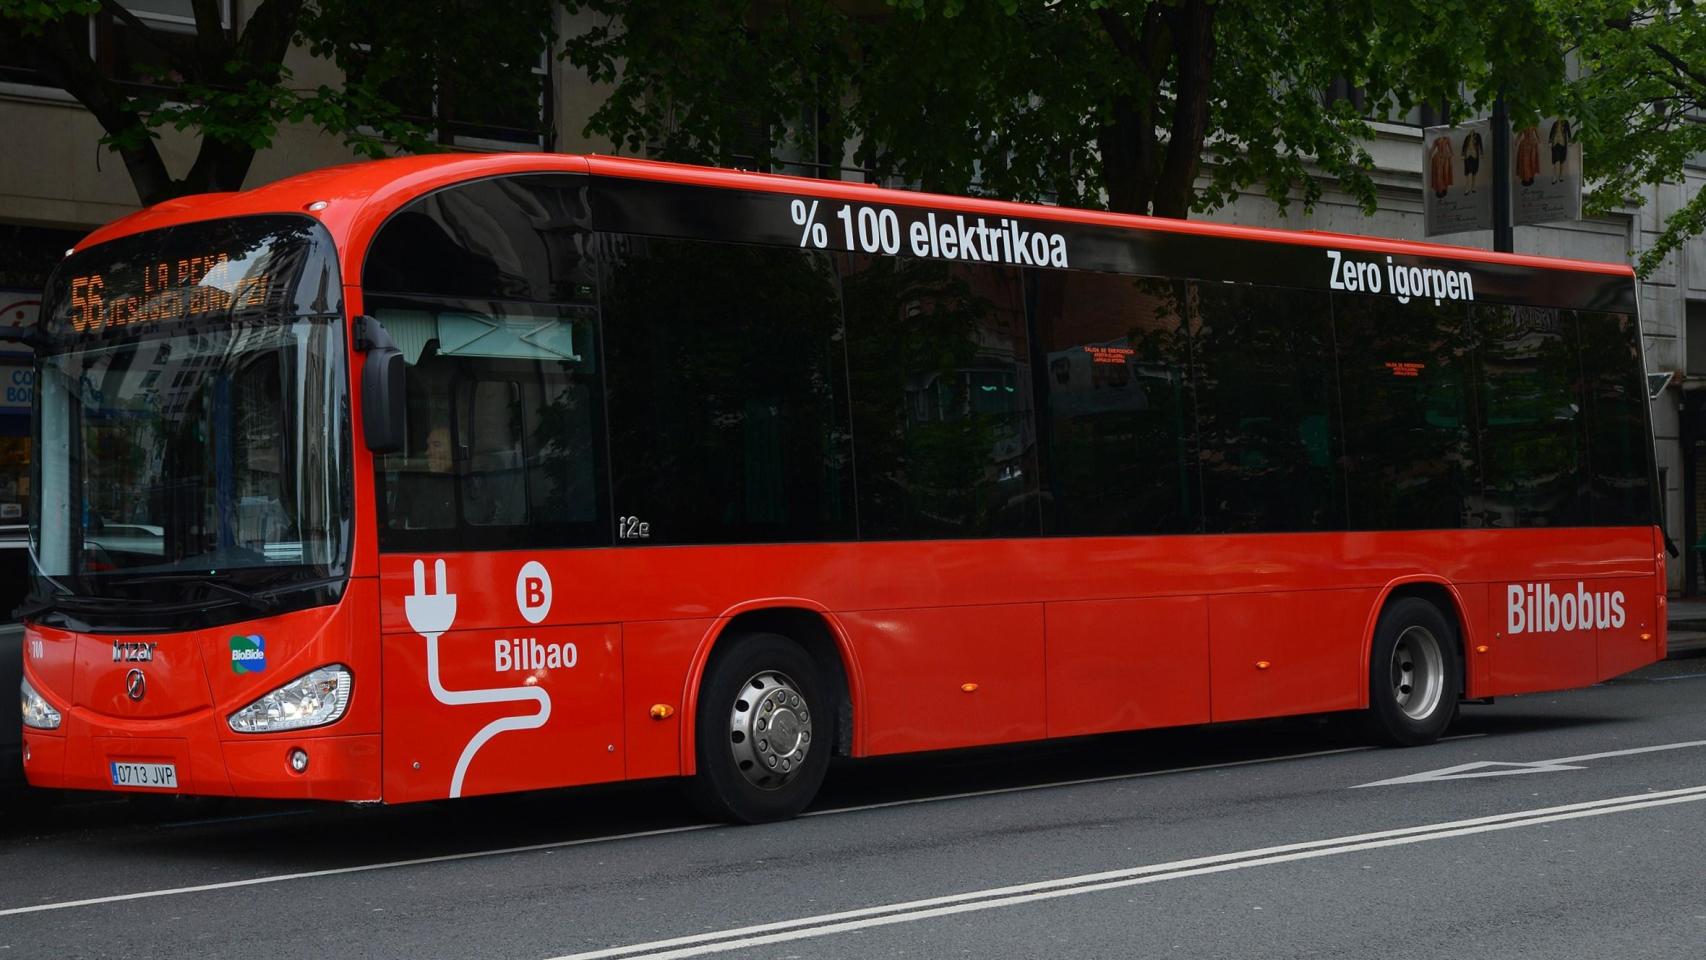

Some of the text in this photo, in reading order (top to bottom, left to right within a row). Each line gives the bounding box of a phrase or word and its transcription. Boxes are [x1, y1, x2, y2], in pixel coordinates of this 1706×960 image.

[791, 199, 1069, 268] % 100 elektrikoa
[145, 263, 169, 293] LA
[1327, 250, 1474, 306] Zero igorpen
[72, 275, 105, 332] 56
[619, 516, 650, 539] i2e
[525, 577, 546, 608] B
[1507, 581, 1626, 634] Bilbobus
[232, 649, 265, 660] BioBide
[494, 638, 578, 672] Bilbao
[118, 765, 173, 785] 0713 JVP
